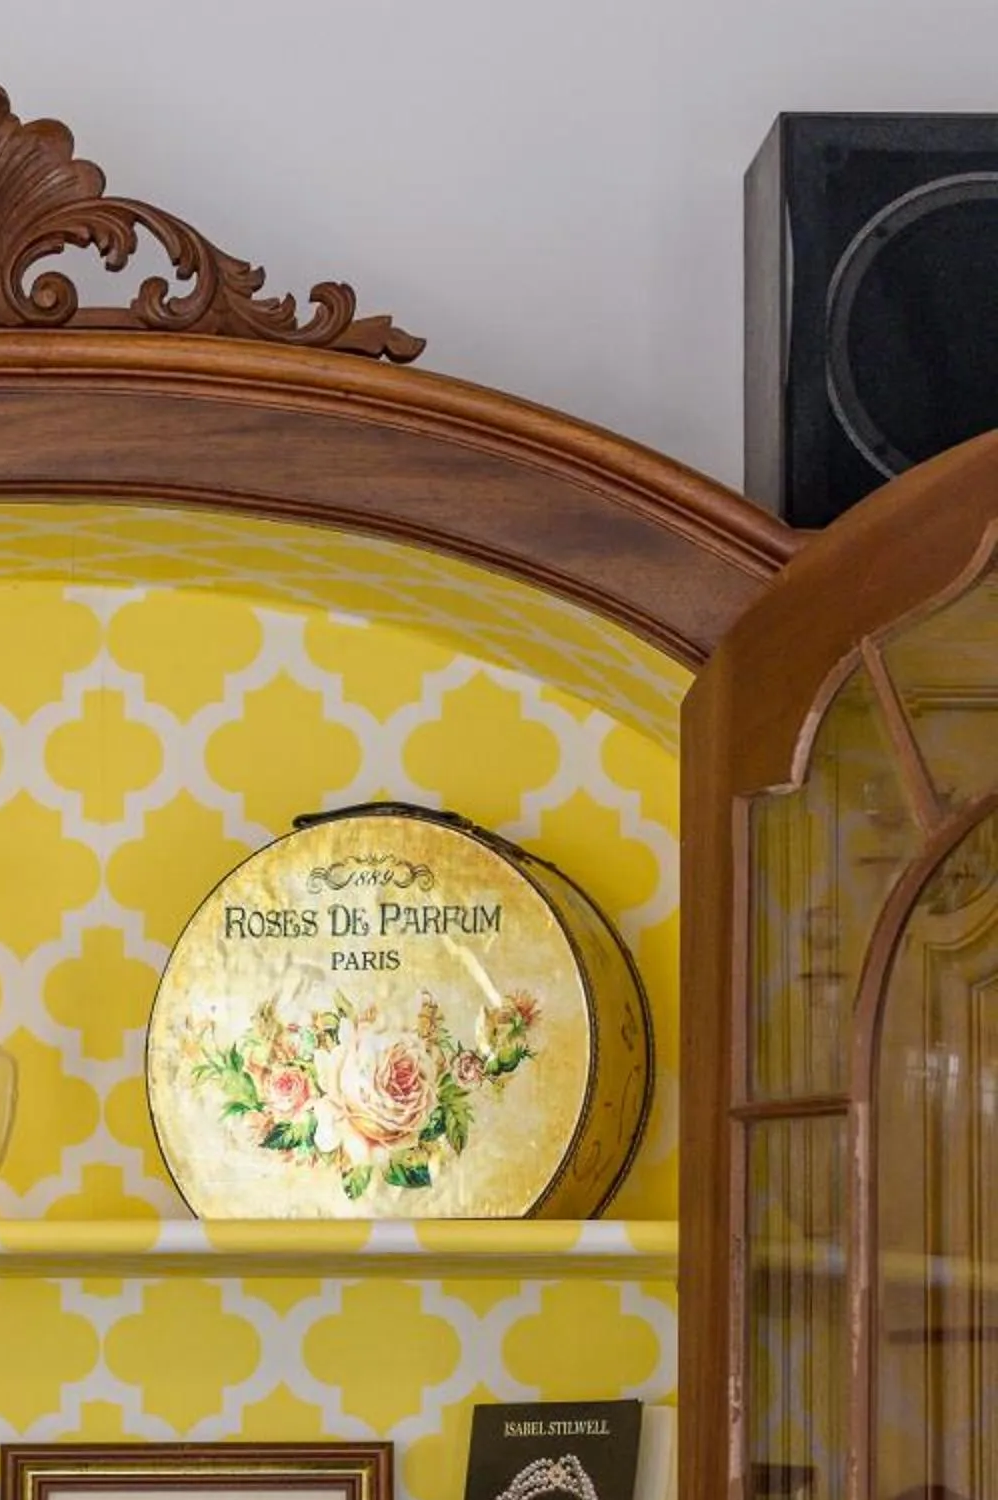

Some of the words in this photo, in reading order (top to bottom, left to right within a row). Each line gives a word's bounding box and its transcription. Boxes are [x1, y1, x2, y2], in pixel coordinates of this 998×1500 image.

[224, 906, 320, 939] ROSES
[379, 902, 502, 937] PARFUM
[331, 950, 401, 971] PARIS
[504, 1421, 546, 1438] ISABEL
[547, 1420, 610, 1436] STILWELL
